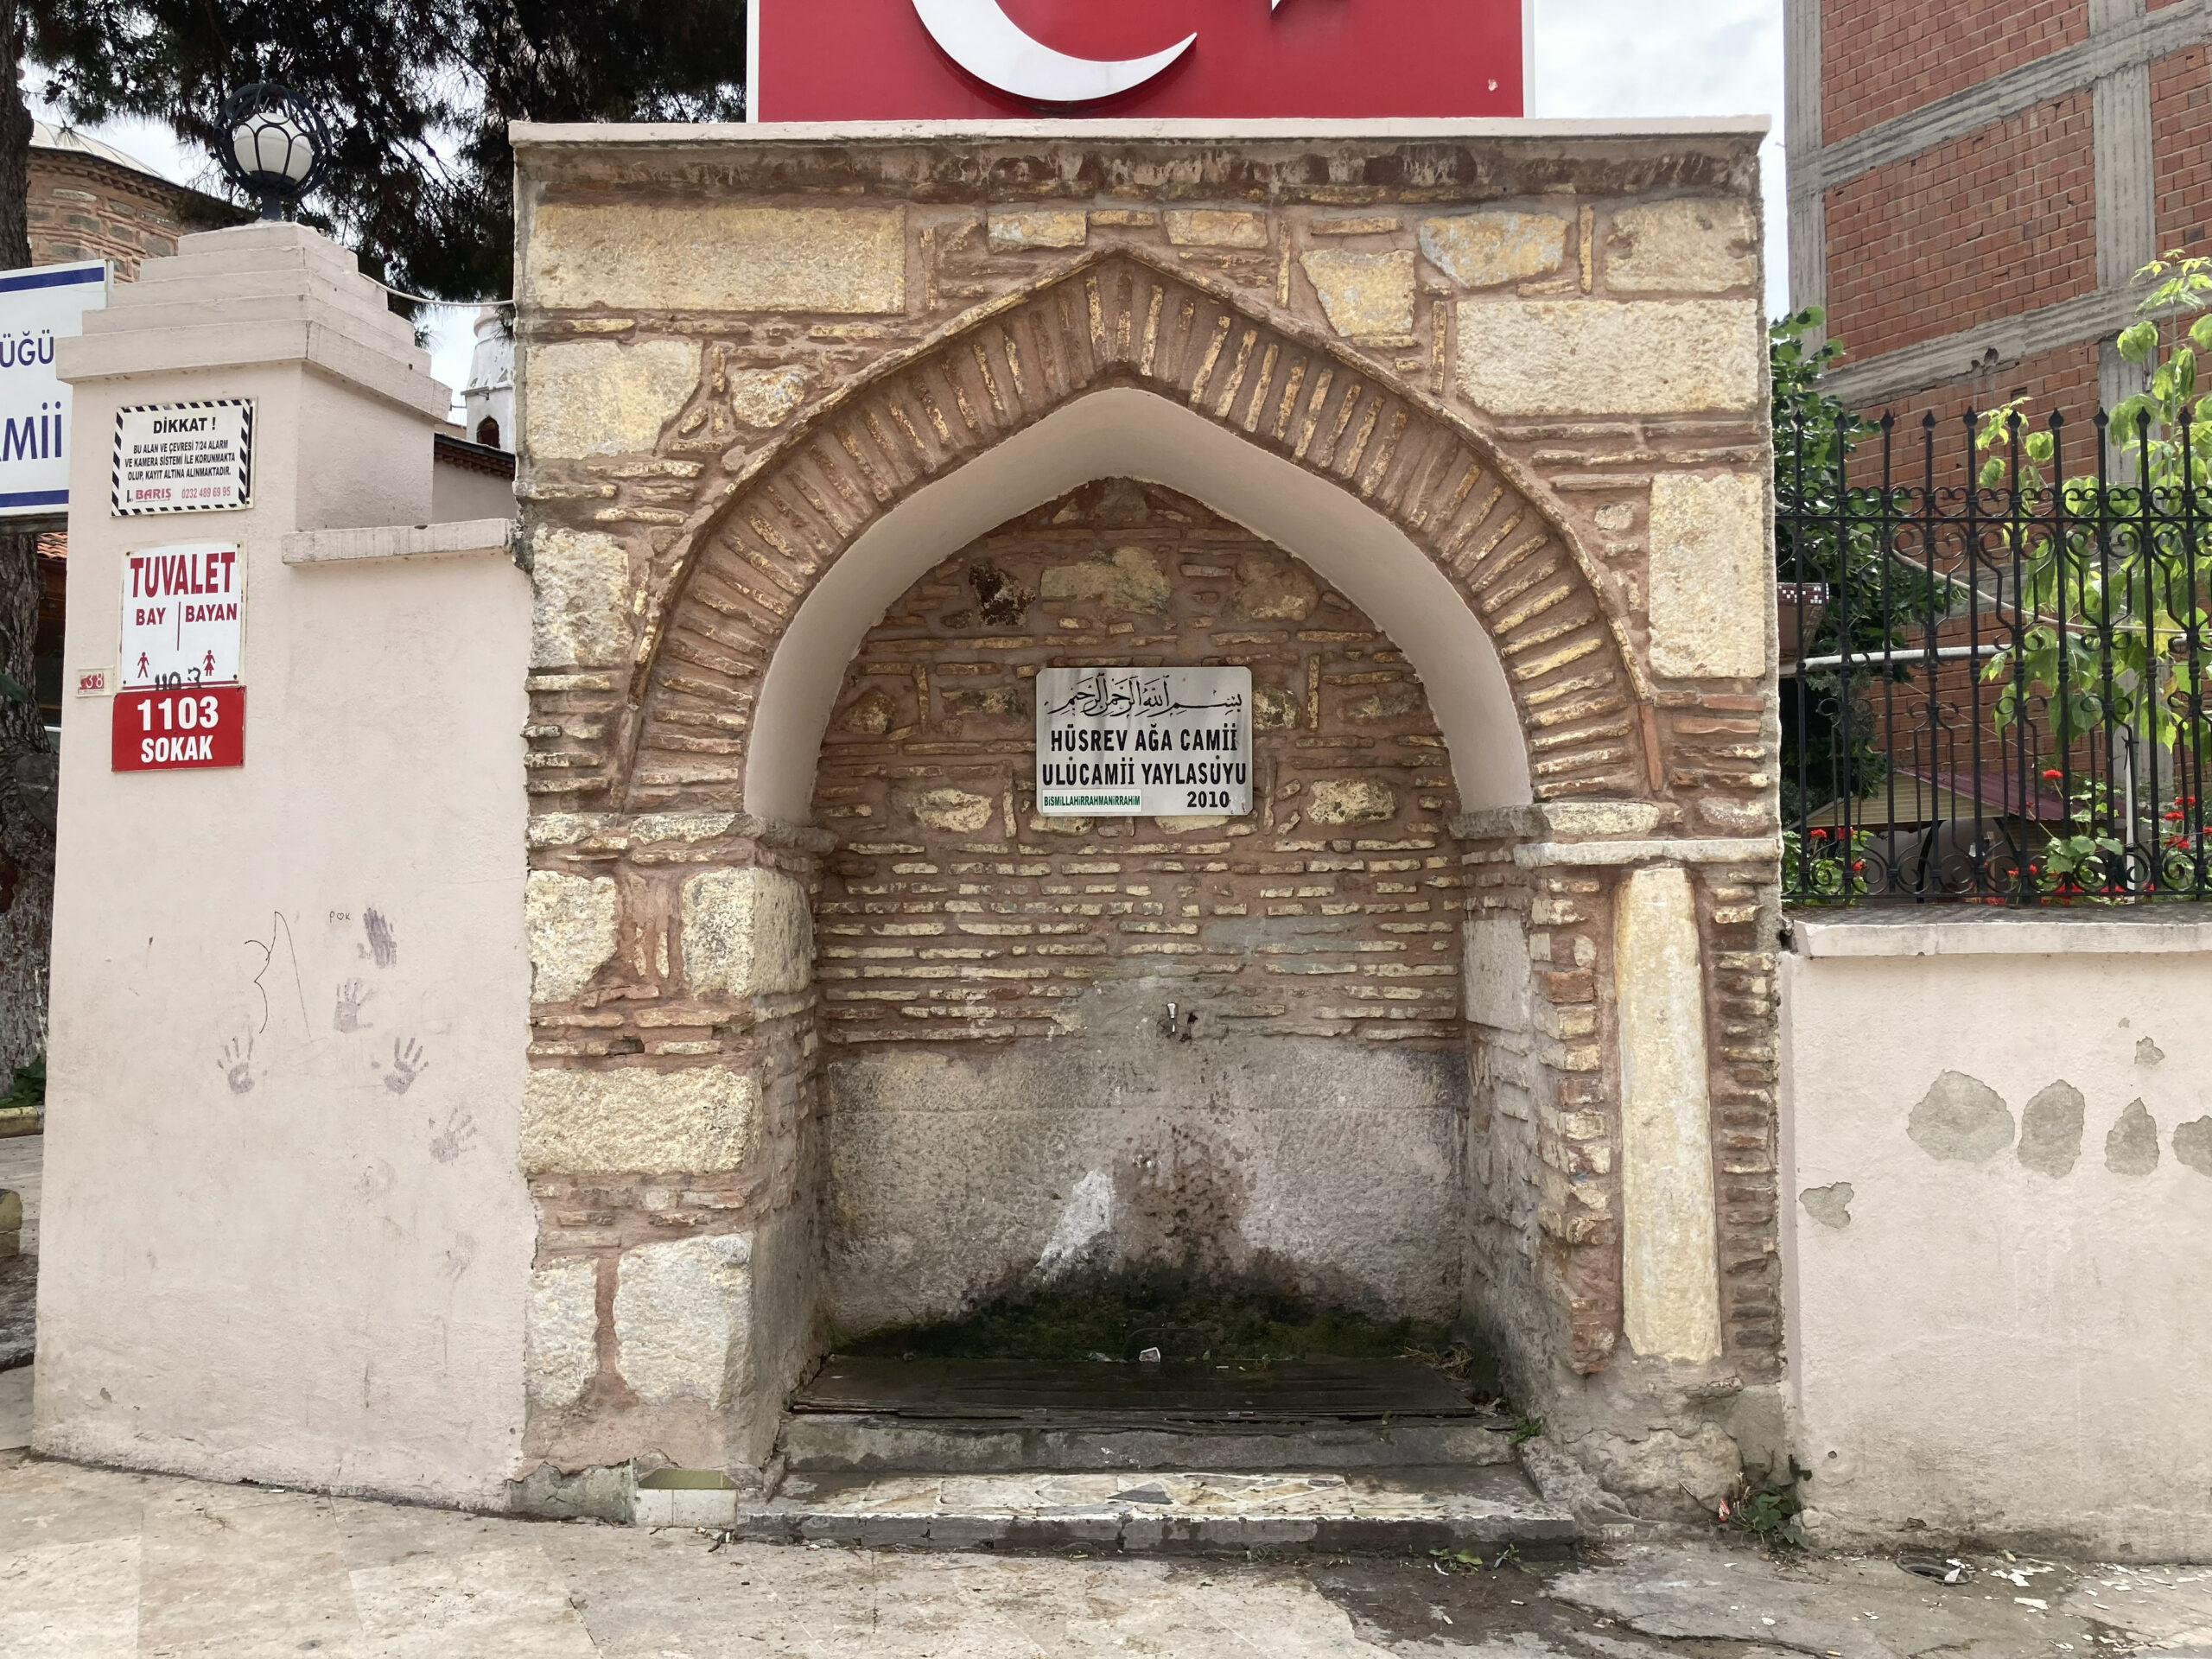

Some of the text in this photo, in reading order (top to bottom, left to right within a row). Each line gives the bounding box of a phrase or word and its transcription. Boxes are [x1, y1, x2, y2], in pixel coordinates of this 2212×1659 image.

[153, 416, 207, 434] DİKKAT
[133, 439, 228, 454] BU ALAN VE ÇEVRESİ 7/24 ALARM
[125, 452, 235, 467] VE KAMERA SİSTEMİ İLE KORUNMAKTA
[128, 467, 231, 482] OLUP, KAYIT ALTINA ALINMAKTADIR.
[136, 486, 231, 500] BARIŞ 0232 489 69 95
[130, 551, 235, 598] TUVALET
[136, 603, 237, 626] BAY BAYAN
[137, 696, 219, 731] 1103
[1051, 722, 1237, 752] HÜSREV AĞA CAMİİ
[141, 735, 213, 763] SOKAK
[1141, 760, 1246, 785] YAYLASUYU
[1187, 791, 1230, 808] 2010
